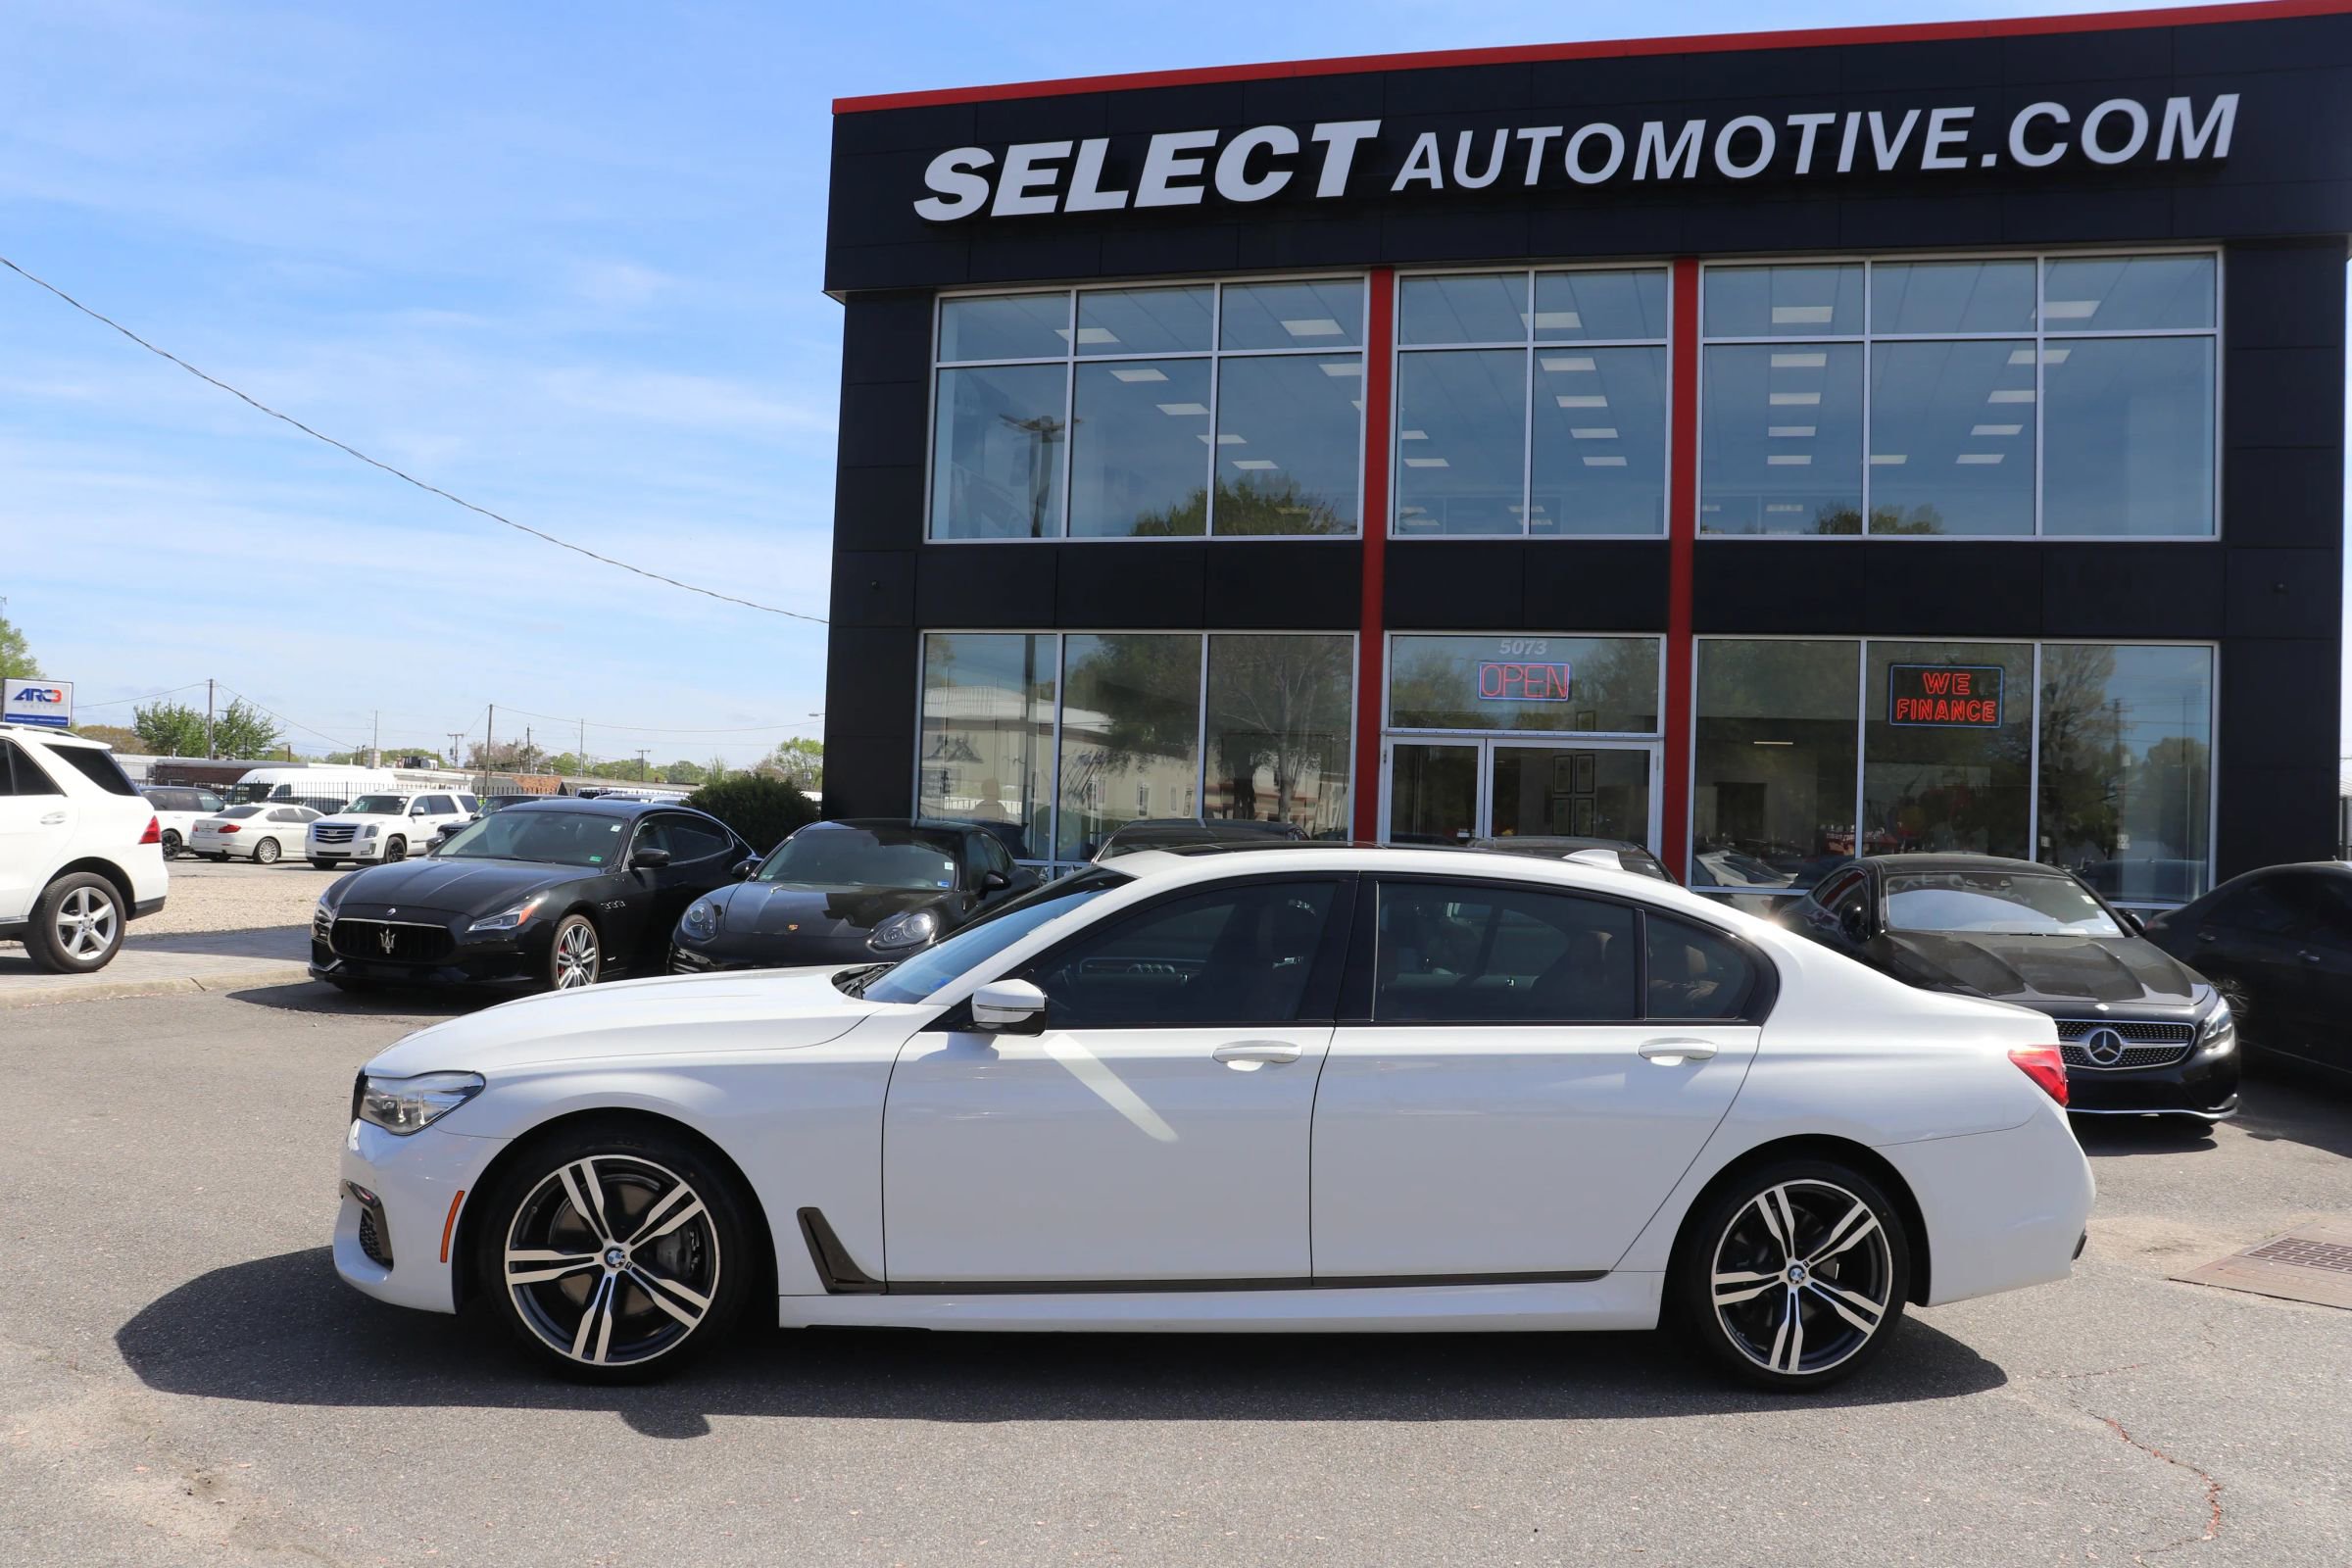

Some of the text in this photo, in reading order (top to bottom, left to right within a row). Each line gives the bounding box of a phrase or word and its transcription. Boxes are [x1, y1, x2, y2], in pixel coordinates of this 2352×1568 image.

[913, 93, 2240, 221] SELECT AUTOMOTIVE.COM
[1498, 639, 1547, 655] 5073
[1482, 664, 1568, 698] OPEN
[1923, 672, 1971, 695] WE
[14, 688, 63, 703] ARC3
[1896, 699, 1996, 721] FINANCE
